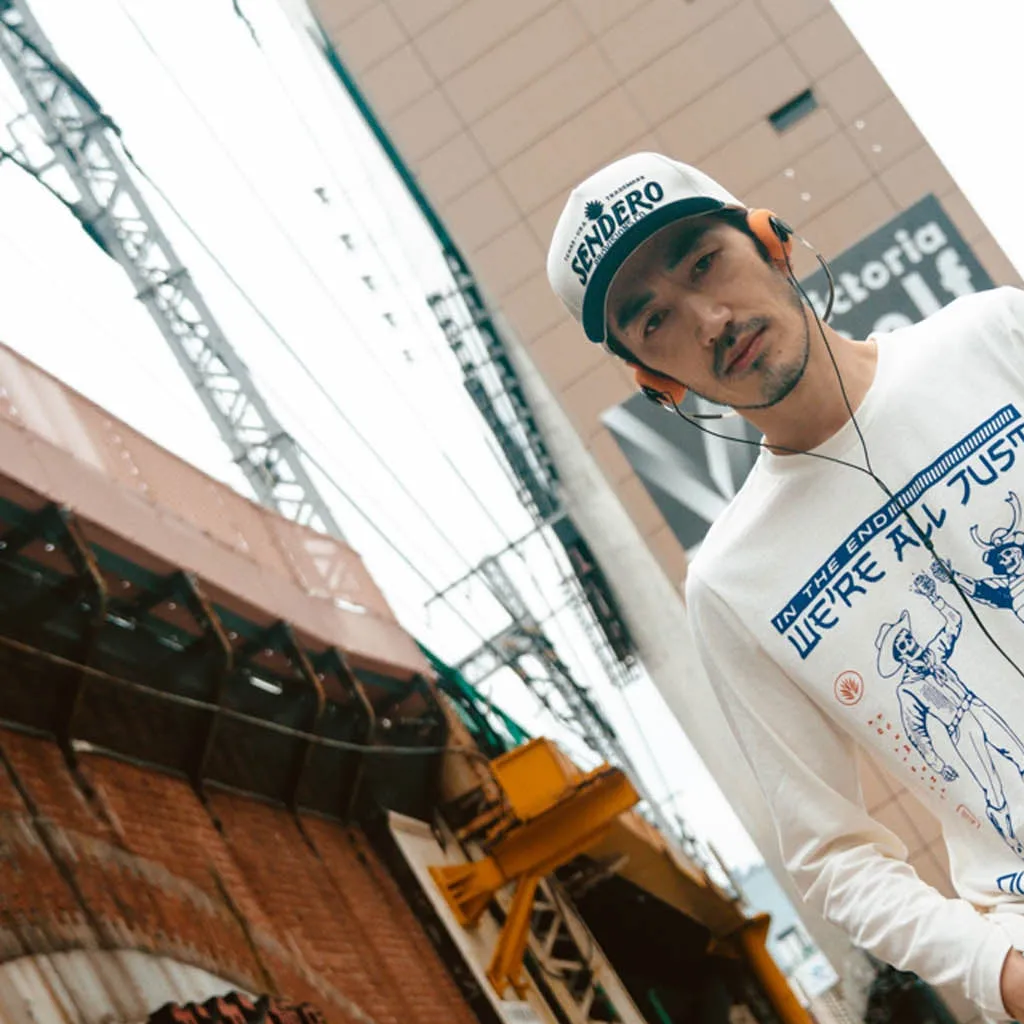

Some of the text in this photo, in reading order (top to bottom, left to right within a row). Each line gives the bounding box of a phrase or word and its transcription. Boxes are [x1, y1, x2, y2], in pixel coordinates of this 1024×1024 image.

[571, 181, 664, 287] SENDERO
[802, 221, 948, 324] ictoria
[776, 513, 888, 630] IN THE END
[788, 551, 886, 660] WE'RE
[885, 503, 947, 562] ALL
